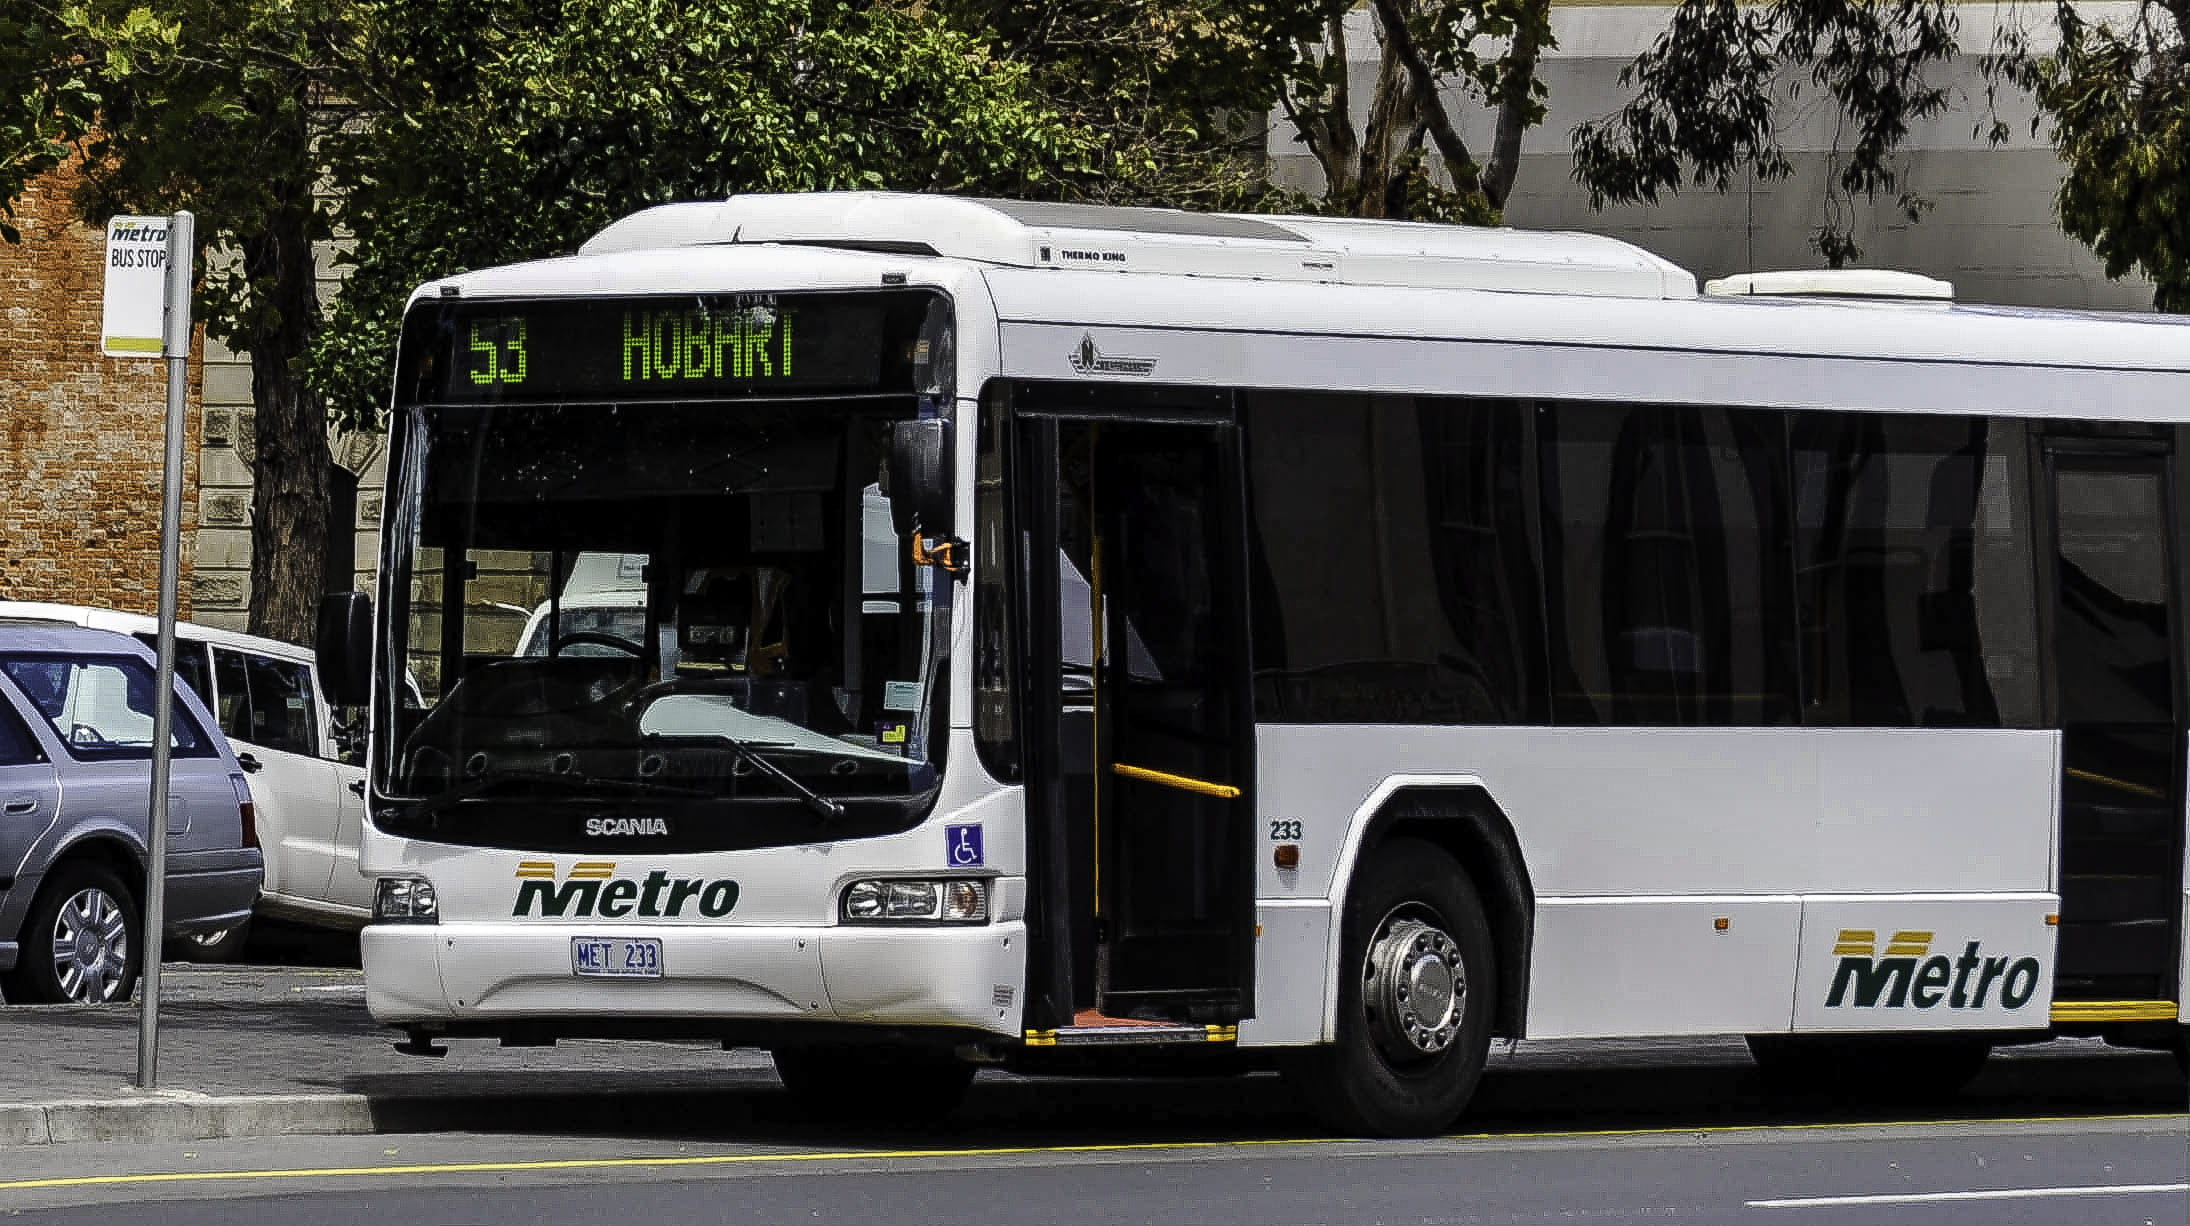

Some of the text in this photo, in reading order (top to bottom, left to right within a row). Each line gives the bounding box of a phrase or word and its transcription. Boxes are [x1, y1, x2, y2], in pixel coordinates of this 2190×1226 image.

[111, 223, 167, 242] Metro
[111, 248, 167, 269] BUS STOP
[1061, 250, 1126, 262] THERMO KING
[471, 310, 797, 384] 53 HOBART
[586, 818, 668, 836] SCANIA
[1270, 820, 1302, 840] 233
[512, 861, 740, 919] Metro
[577, 943, 657, 968] MET 233
[1824, 930, 2040, 1010] Metro
